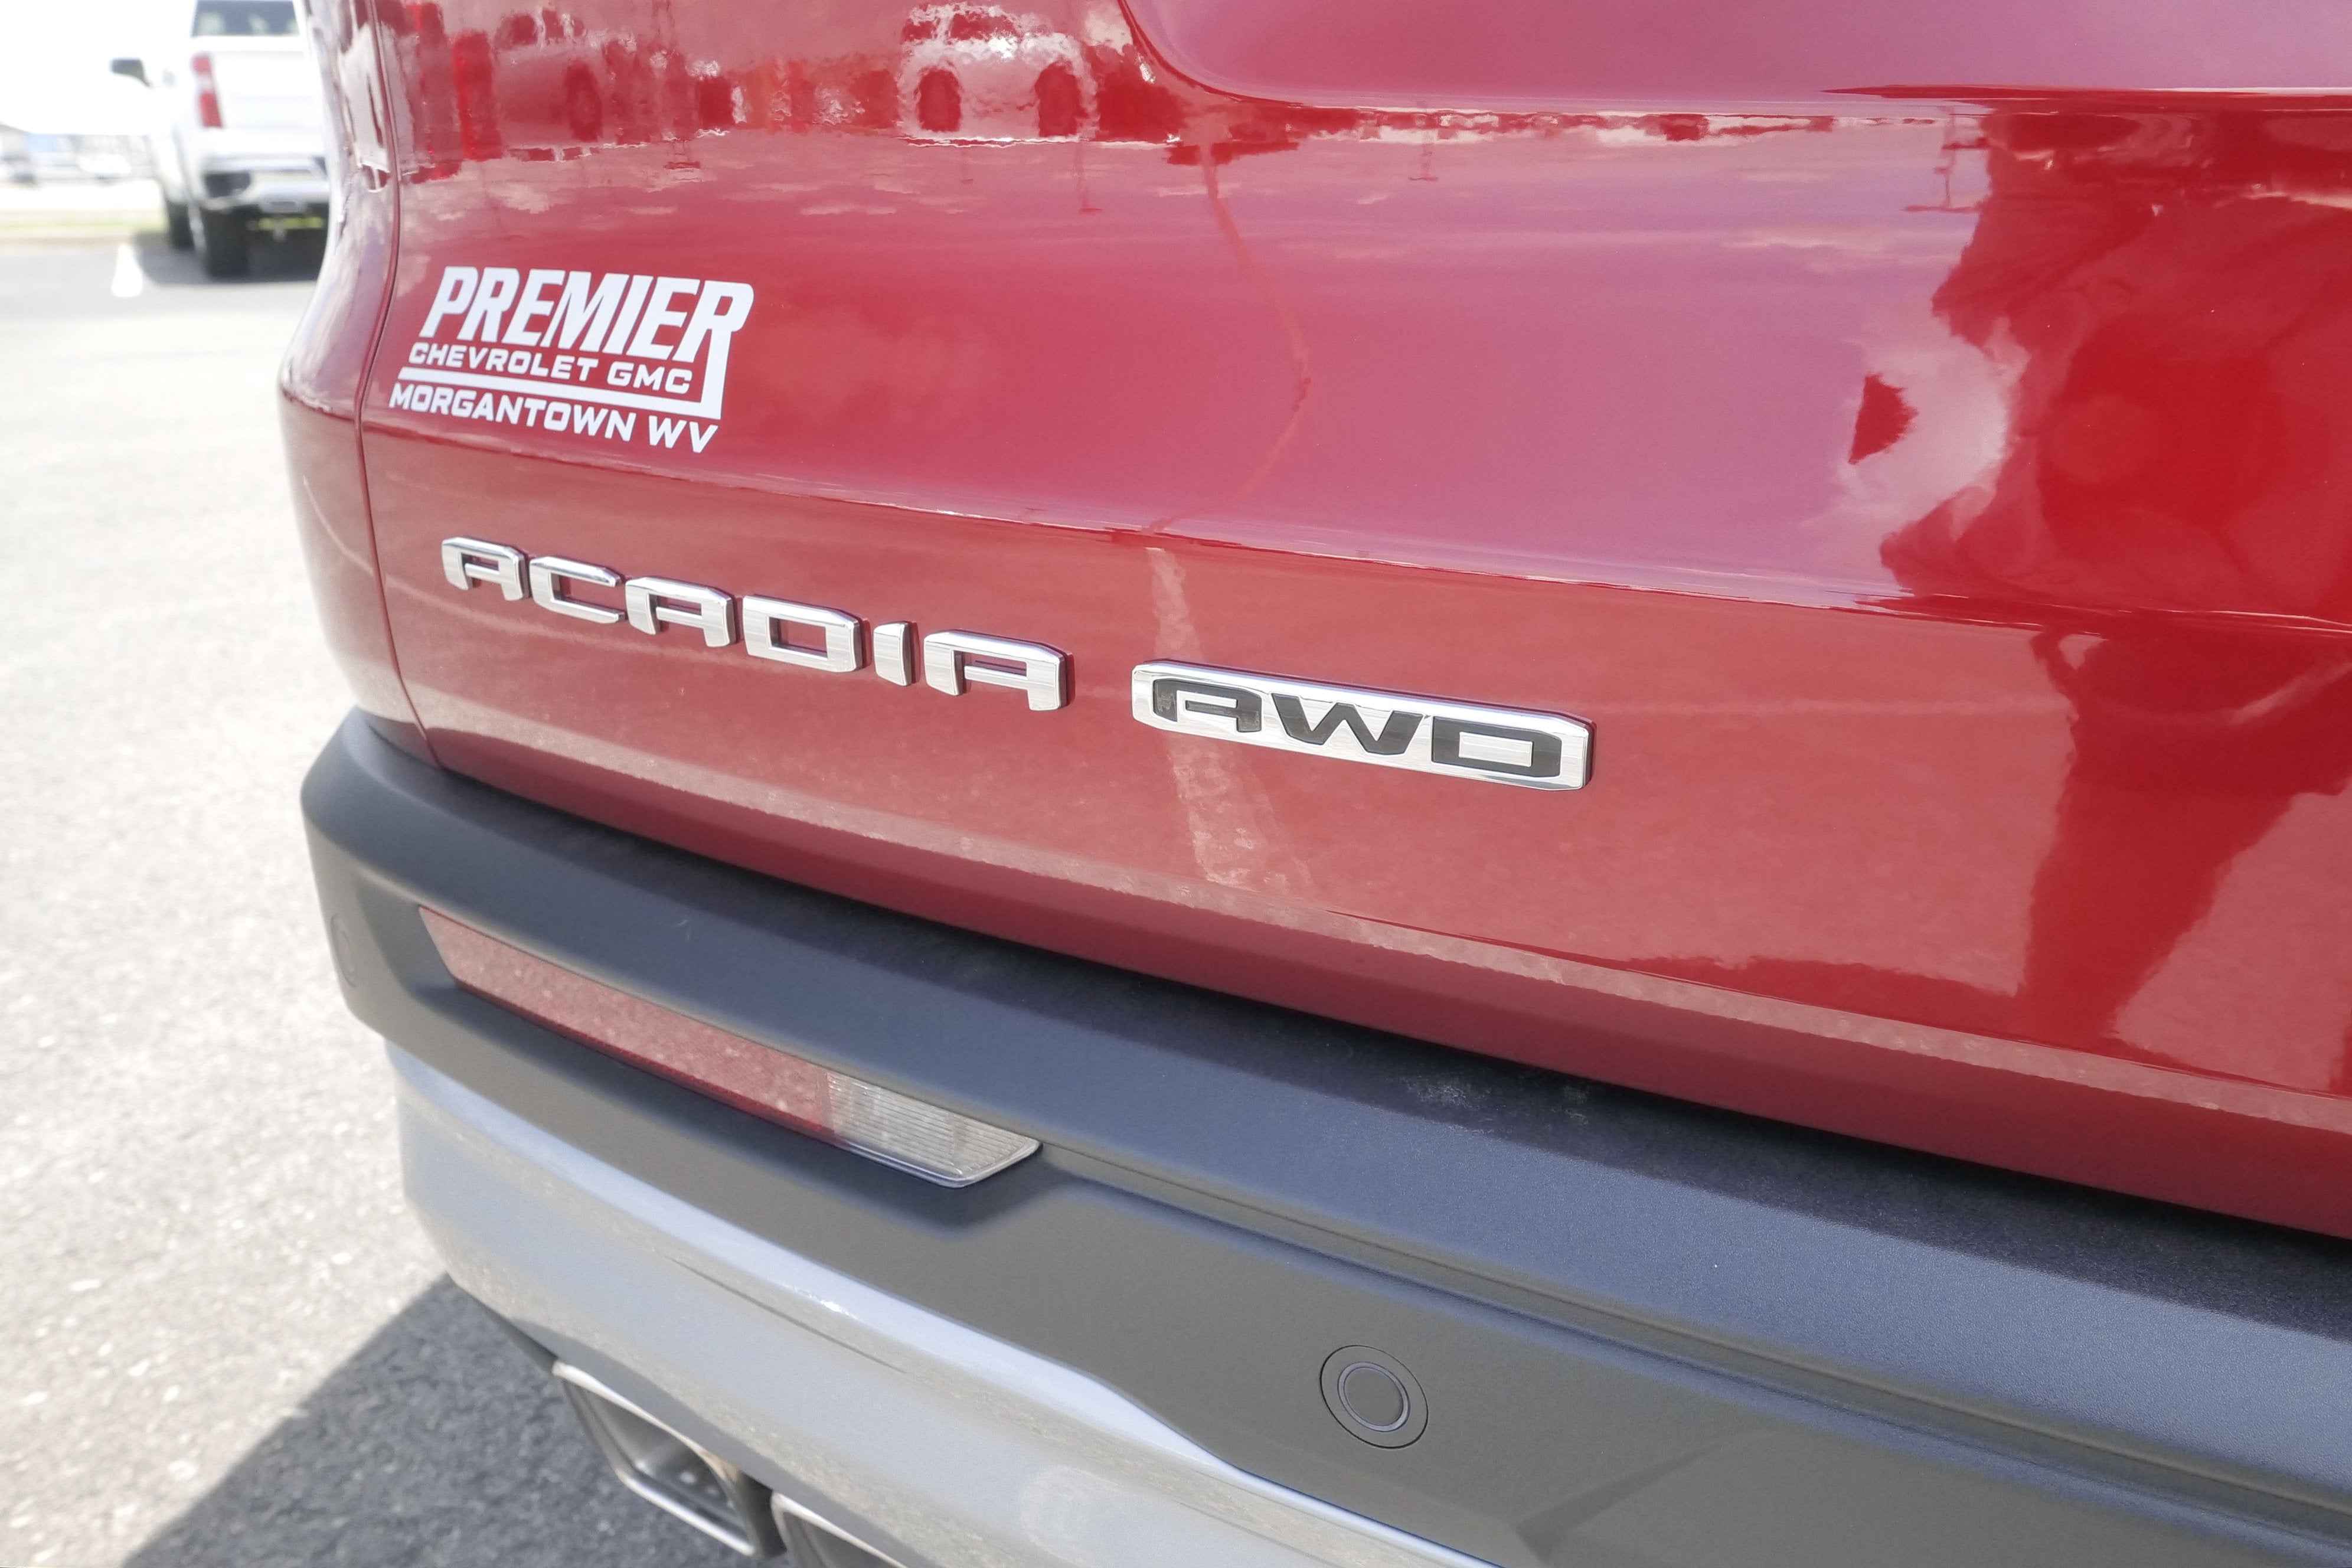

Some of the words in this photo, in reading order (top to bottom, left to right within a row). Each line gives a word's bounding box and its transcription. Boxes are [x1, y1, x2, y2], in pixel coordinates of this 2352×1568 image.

[419, 266, 754, 364] PREMIER
[409, 342, 599, 381] CHEVROLET
[607, 362, 692, 394] GMC
[388, 382, 636, 442] MORGANTOWN
[649, 415, 718, 454] WV
[441, 537, 1076, 711] ACADIA
[1152, 678, 1562, 778] AWD
